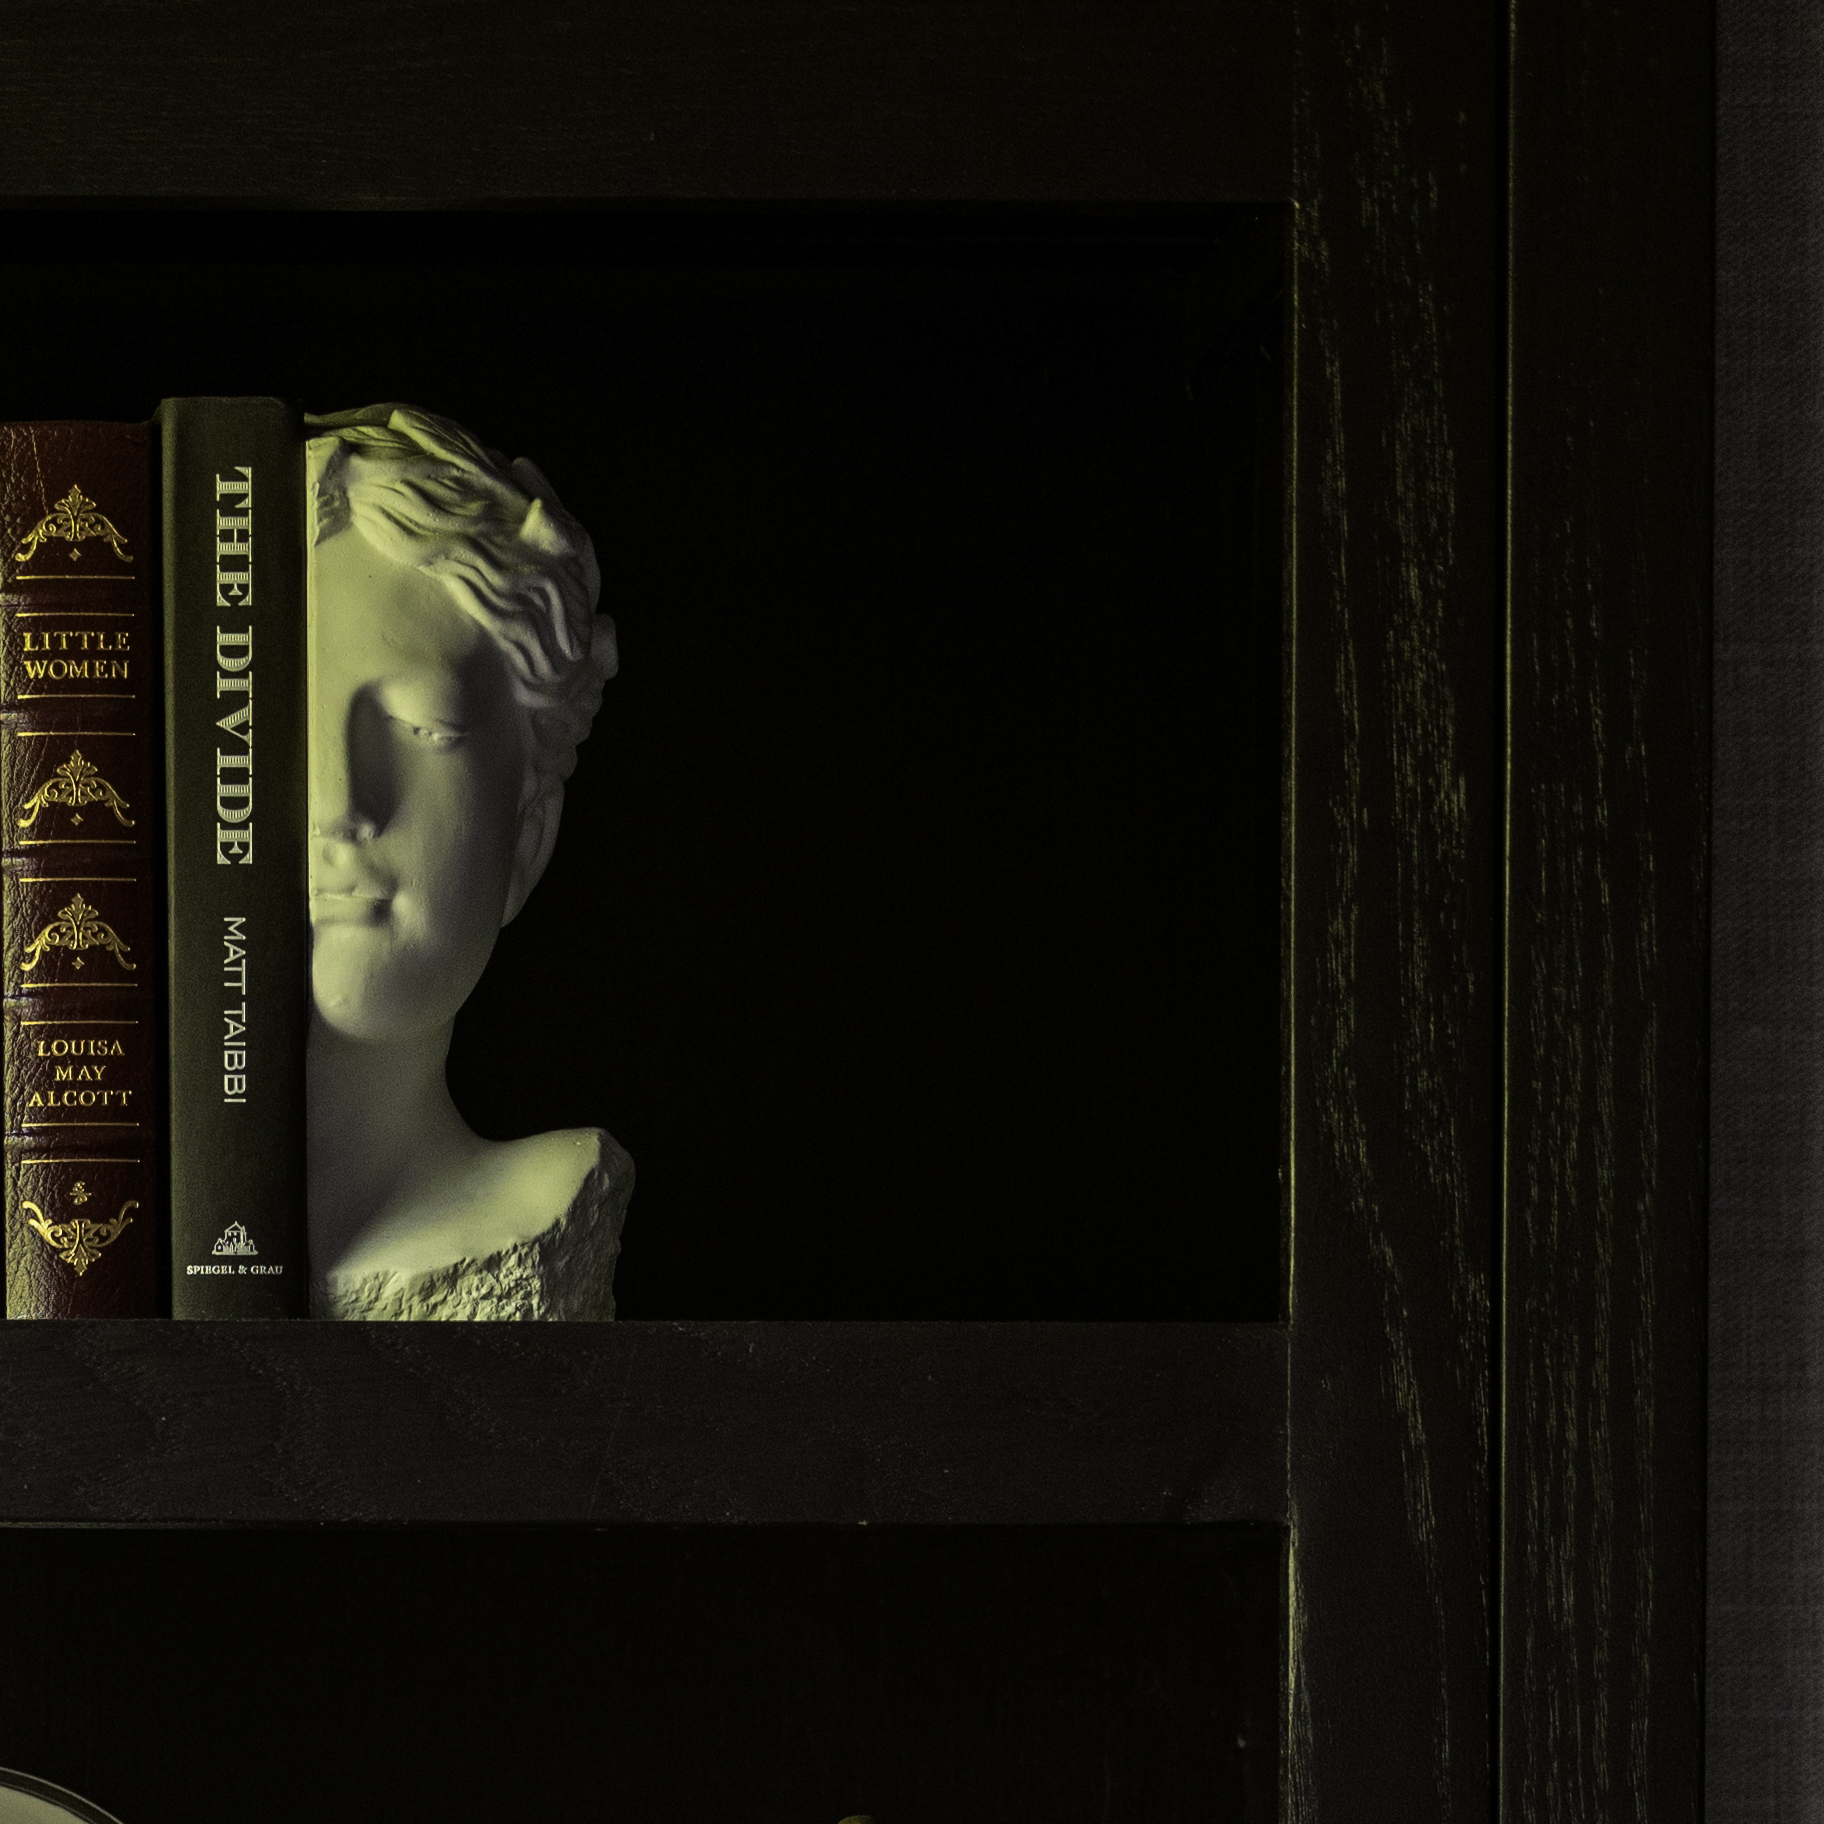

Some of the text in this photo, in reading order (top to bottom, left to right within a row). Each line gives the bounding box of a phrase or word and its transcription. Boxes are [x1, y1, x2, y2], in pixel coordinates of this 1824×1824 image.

[22, 631, 130, 651] LITTLE
[23, 659, 130, 680] WOMEN
[215, 466, 253, 865] THE DIVIDE
[223, 916, 246, 1103] MATT TAIBBI
[37, 1039, 125, 1056] LOUISA
[54, 1065, 106, 1081] MAY
[28, 1090, 133, 1107] ALCOTT
[186, 1265, 284, 1275] SPIEGEL & GRAU
